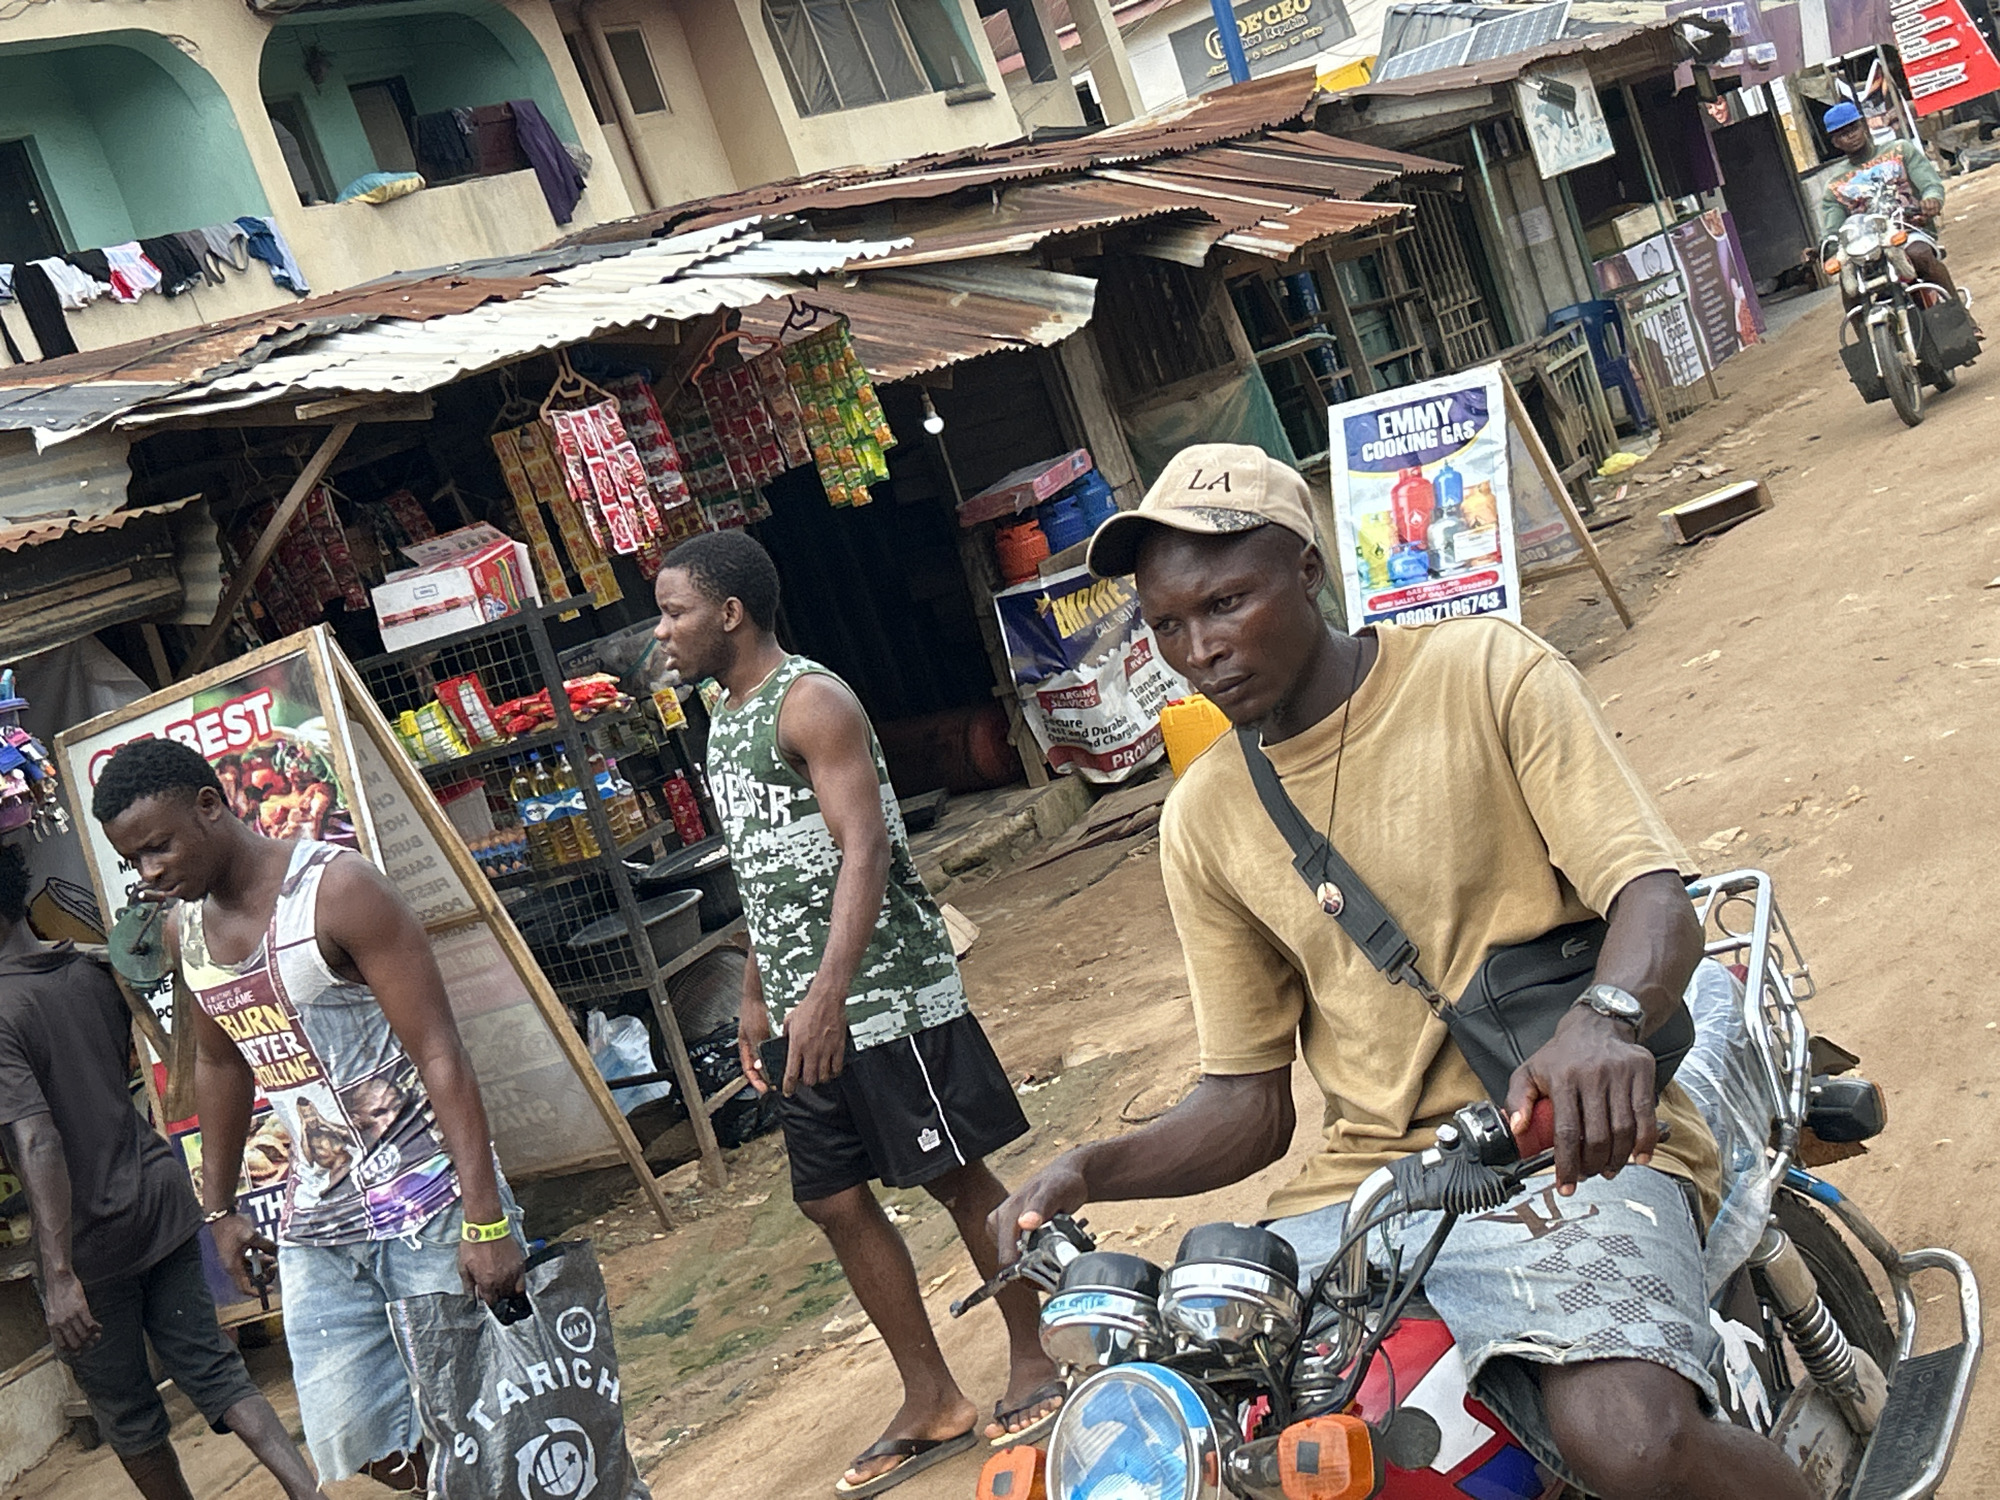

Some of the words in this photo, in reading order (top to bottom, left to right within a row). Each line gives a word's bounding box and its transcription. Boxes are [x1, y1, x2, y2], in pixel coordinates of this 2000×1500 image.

[1377, 398, 1454, 440] EMMY
[1361, 429, 1438, 463] COOKING
[1441, 420, 1476, 445] GAS
[1188, 468, 1231, 493] LA
[207, 1000, 226, 1015] THE
[227, 990, 255, 1009] GAME
[214, 1003, 292, 1042] BURN
[236, 1032, 307, 1067] AFTER
[563, 1320, 589, 1341] MAX
[454, 1357, 621, 1464] STARICH
